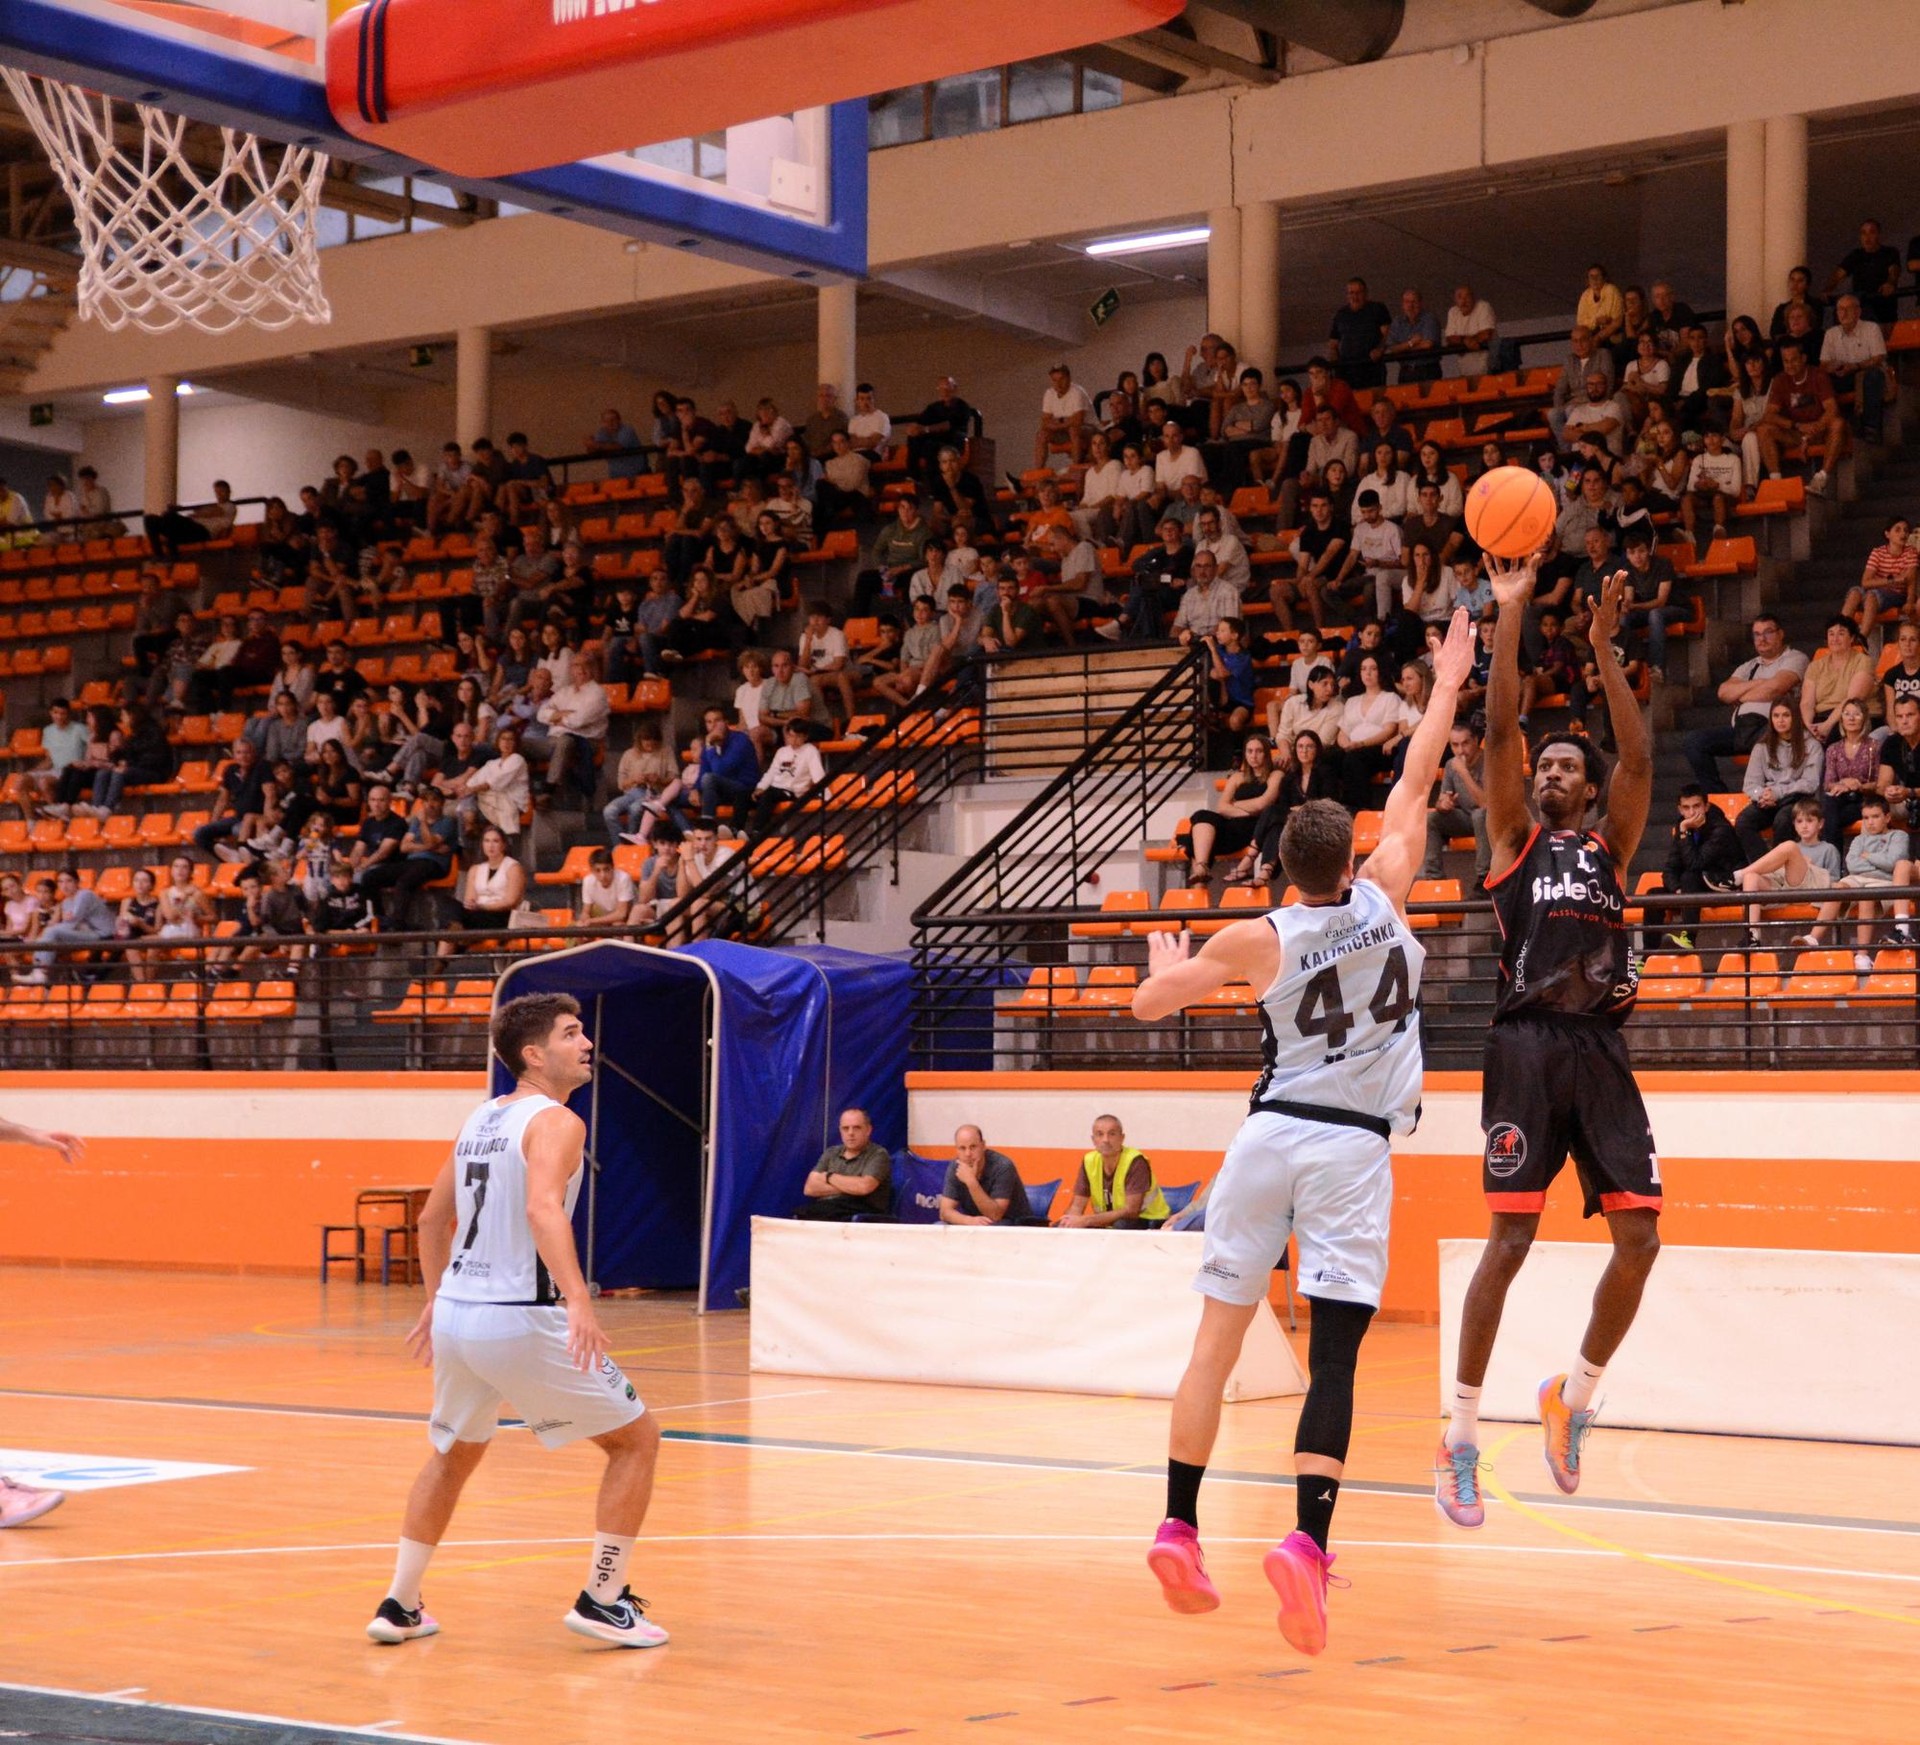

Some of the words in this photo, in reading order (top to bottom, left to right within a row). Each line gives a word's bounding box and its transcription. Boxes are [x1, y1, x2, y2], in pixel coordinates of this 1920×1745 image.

[1294, 945, 1414, 1049] 44
[464, 1162, 489, 1250] 7
[596, 1544, 620, 1588] fleje.
